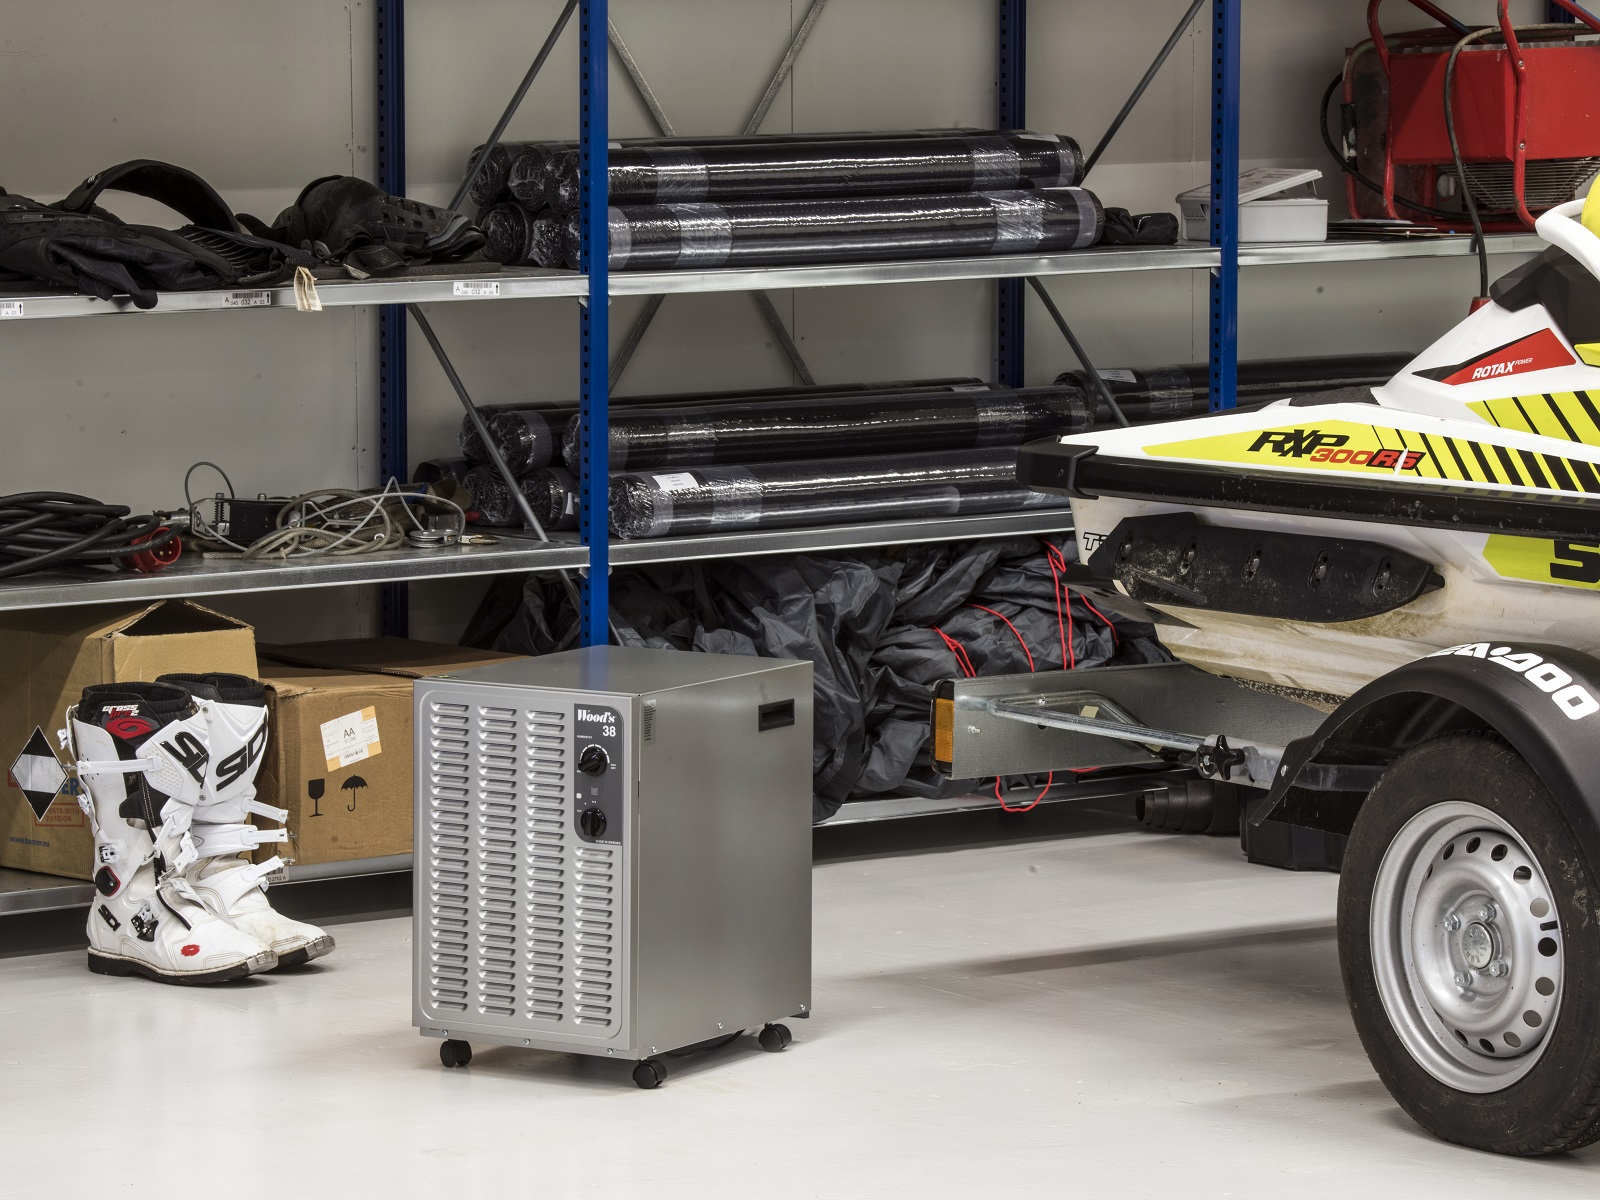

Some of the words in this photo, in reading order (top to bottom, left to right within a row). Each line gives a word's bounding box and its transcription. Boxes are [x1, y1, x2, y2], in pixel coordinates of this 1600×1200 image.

[1471, 361, 1515, 380] ROTAX
[1514, 357, 1534, 366] POWER
[1246, 428, 1350, 458] RXP
[577, 708, 617, 724] Wood's
[343, 727, 356, 739] AA
[602, 725, 616, 738] 38
